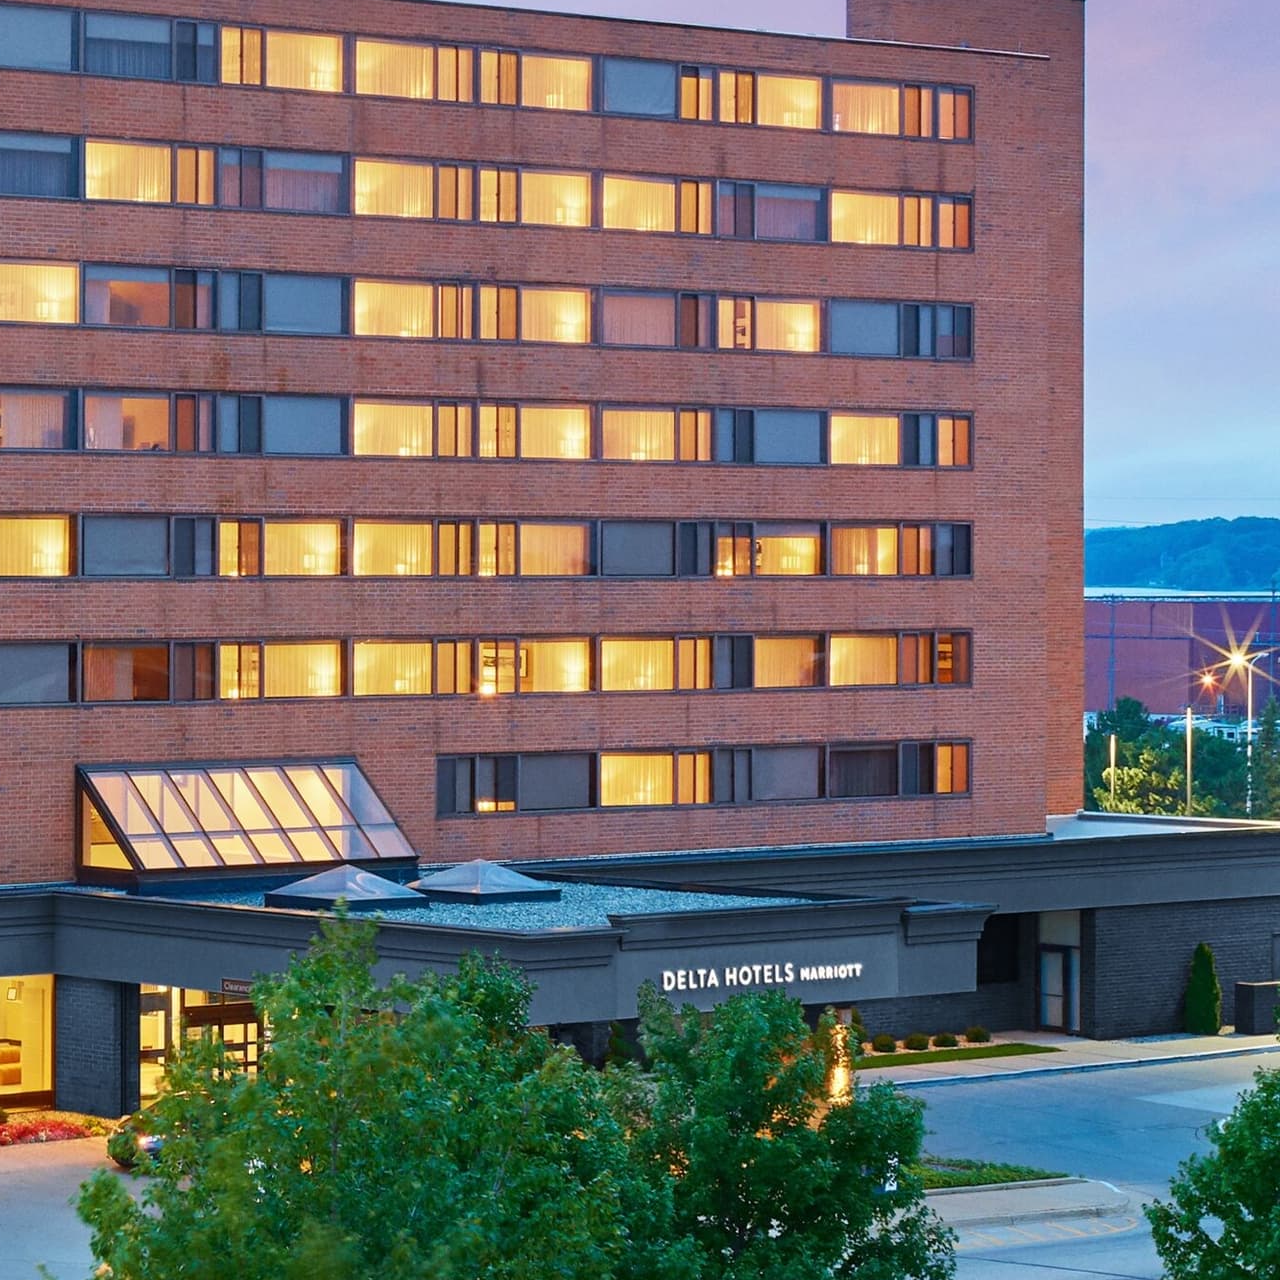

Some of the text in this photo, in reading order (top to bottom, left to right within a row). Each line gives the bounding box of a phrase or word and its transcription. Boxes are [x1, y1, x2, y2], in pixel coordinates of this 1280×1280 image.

[663, 963, 863, 991] DELTA HOTELS MARRIOTT
